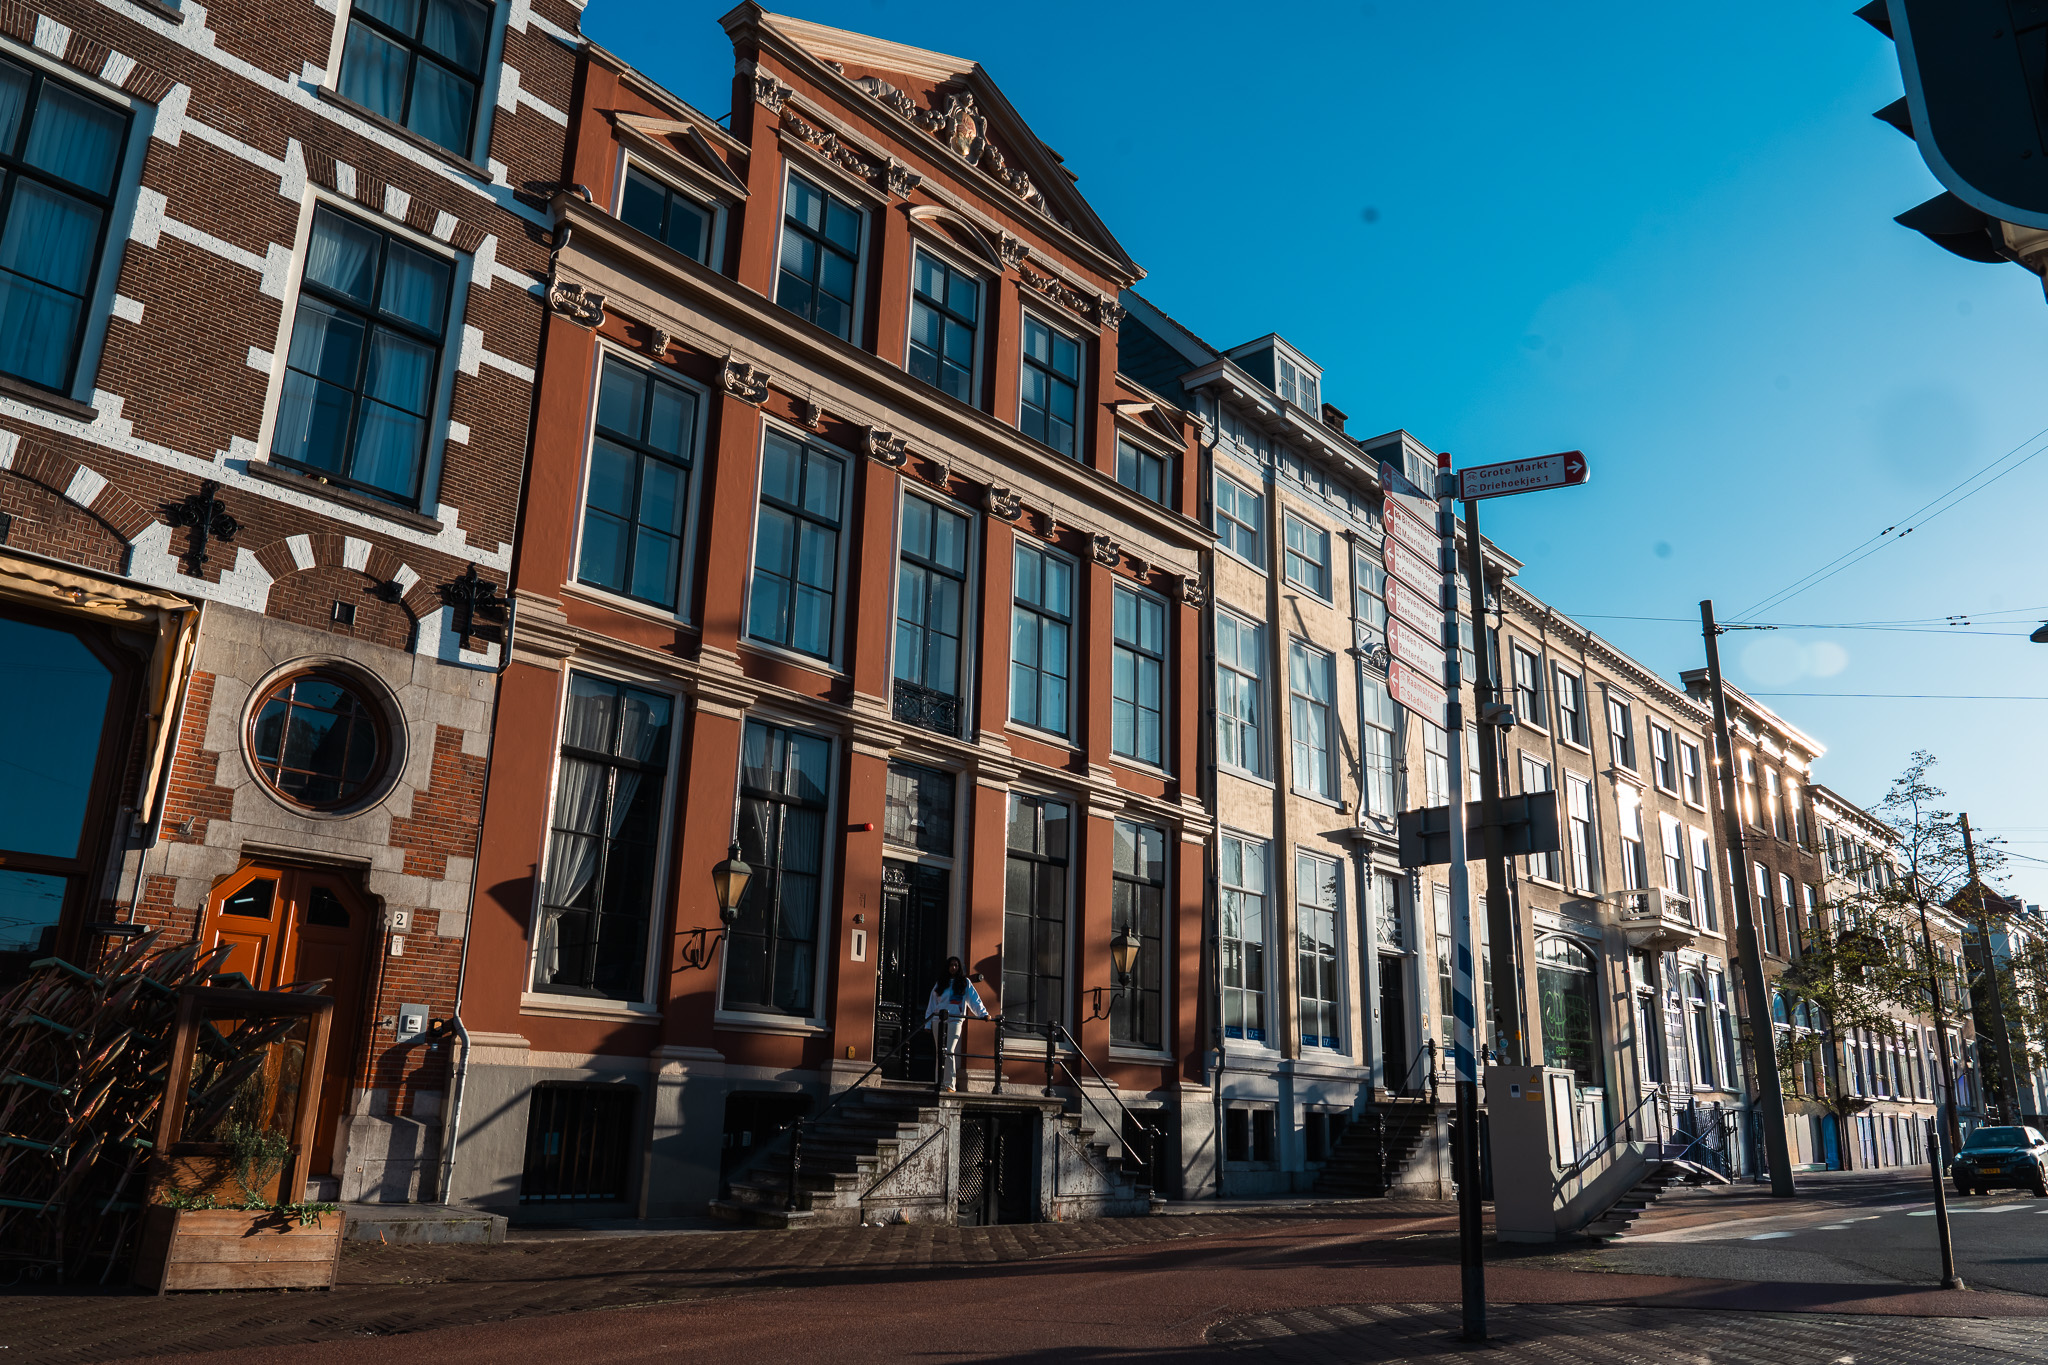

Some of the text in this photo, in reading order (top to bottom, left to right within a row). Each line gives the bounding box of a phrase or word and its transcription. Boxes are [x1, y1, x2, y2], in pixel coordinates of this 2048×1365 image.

[1480, 467, 1511, 479] Grote
[1515, 460, 1549, 474] Markt
[1480, 476, 1541, 492] Driehoekjes
[1402, 515, 1430, 543] Binnenhof
[1402, 529, 1435, 560] Mauritshuis
[1401, 552, 1424, 575] Hollands
[1401, 566, 1422, 586] Centraal
[1396, 587, 1436, 620] Scheveningen
[1397, 601, 1430, 629] Zoetermeer
[1398, 627, 1417, 647] Leiden
[1398, 642, 1429, 667] Rotterdam
[1406, 675, 1440, 704] Raamstraat
[1406, 690, 1433, 714] Stadhuis
[396, 913, 404, 926] 2
